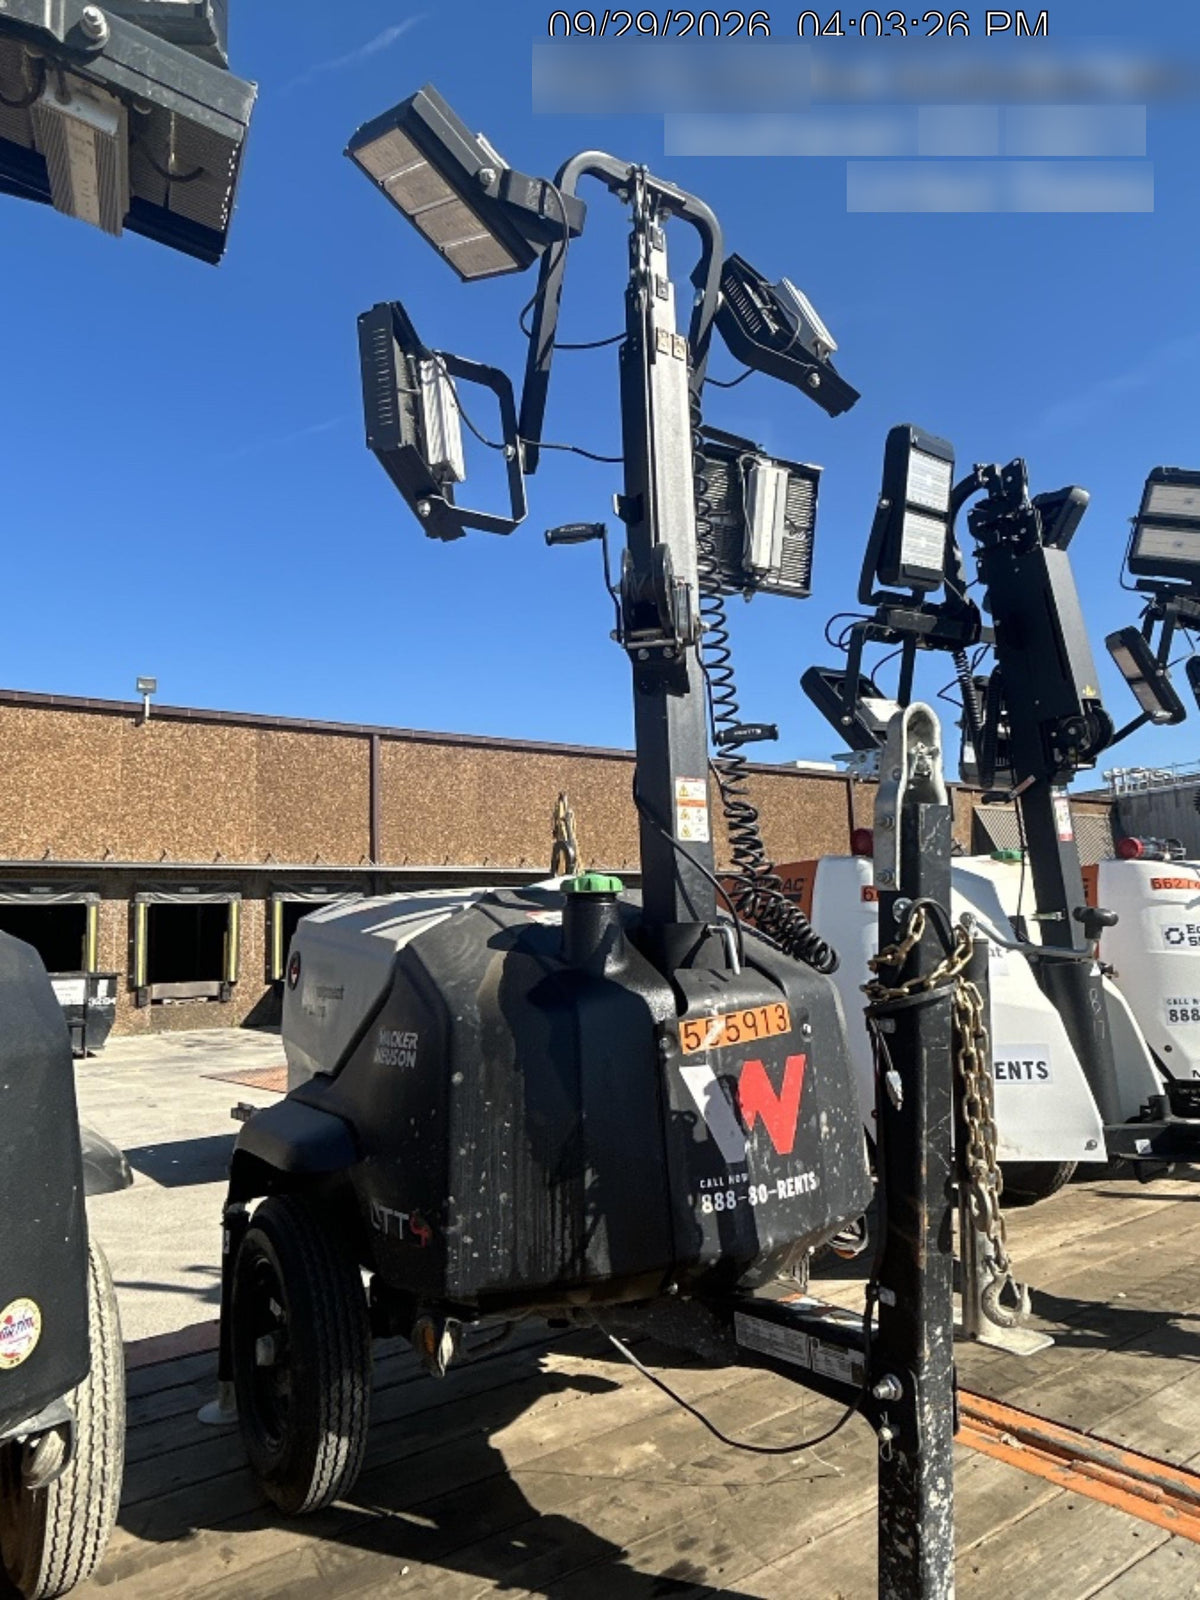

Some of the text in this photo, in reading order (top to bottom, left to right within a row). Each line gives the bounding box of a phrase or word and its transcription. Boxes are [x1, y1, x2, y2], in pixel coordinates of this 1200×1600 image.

[700, 1173, 748, 1188] CALL NOW
[701, 1171, 820, 1214] 888-80-RENTS
